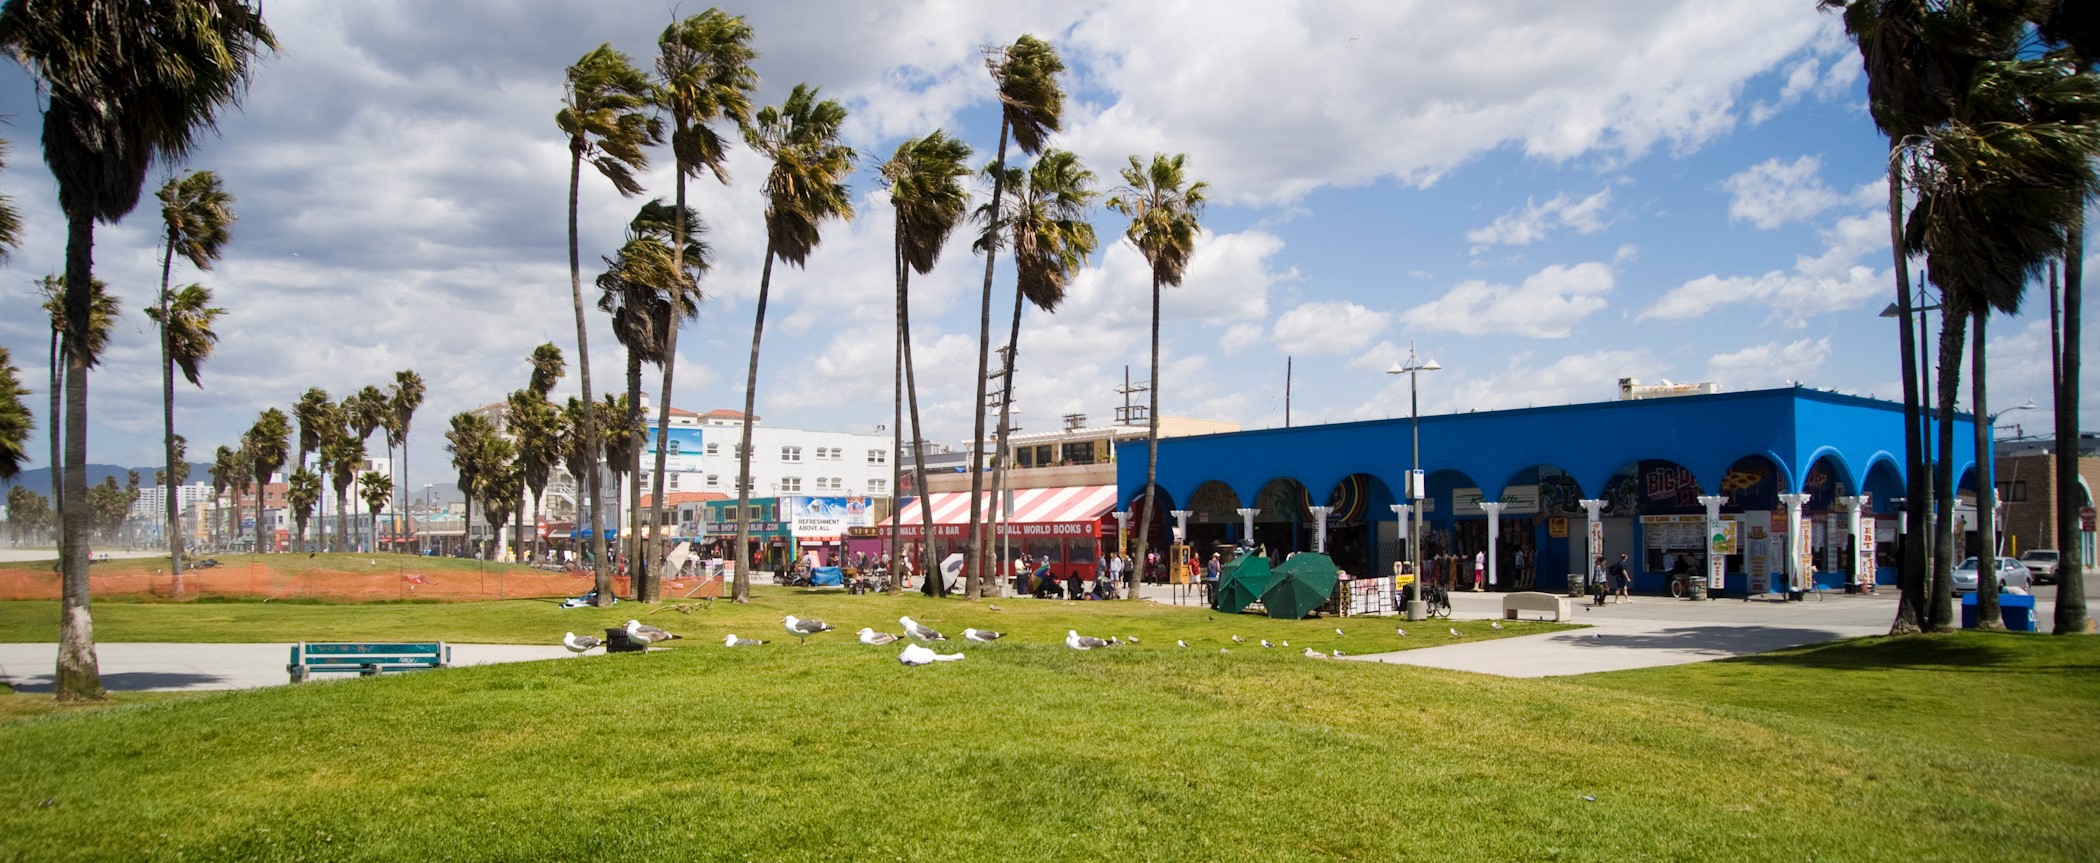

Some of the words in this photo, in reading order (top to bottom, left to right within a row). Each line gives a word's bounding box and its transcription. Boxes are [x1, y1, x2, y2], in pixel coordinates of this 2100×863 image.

[750, 523, 764, 531] BLUE
[886, 527, 917, 536] SIWALK
[938, 526, 944, 535] &
[945, 526, 960, 535] BAR
[1024, 524, 1051, 534] WORLD
[1053, 524, 1081, 534] BOOKS
[1341, 581, 1349, 617] TATTOOS
